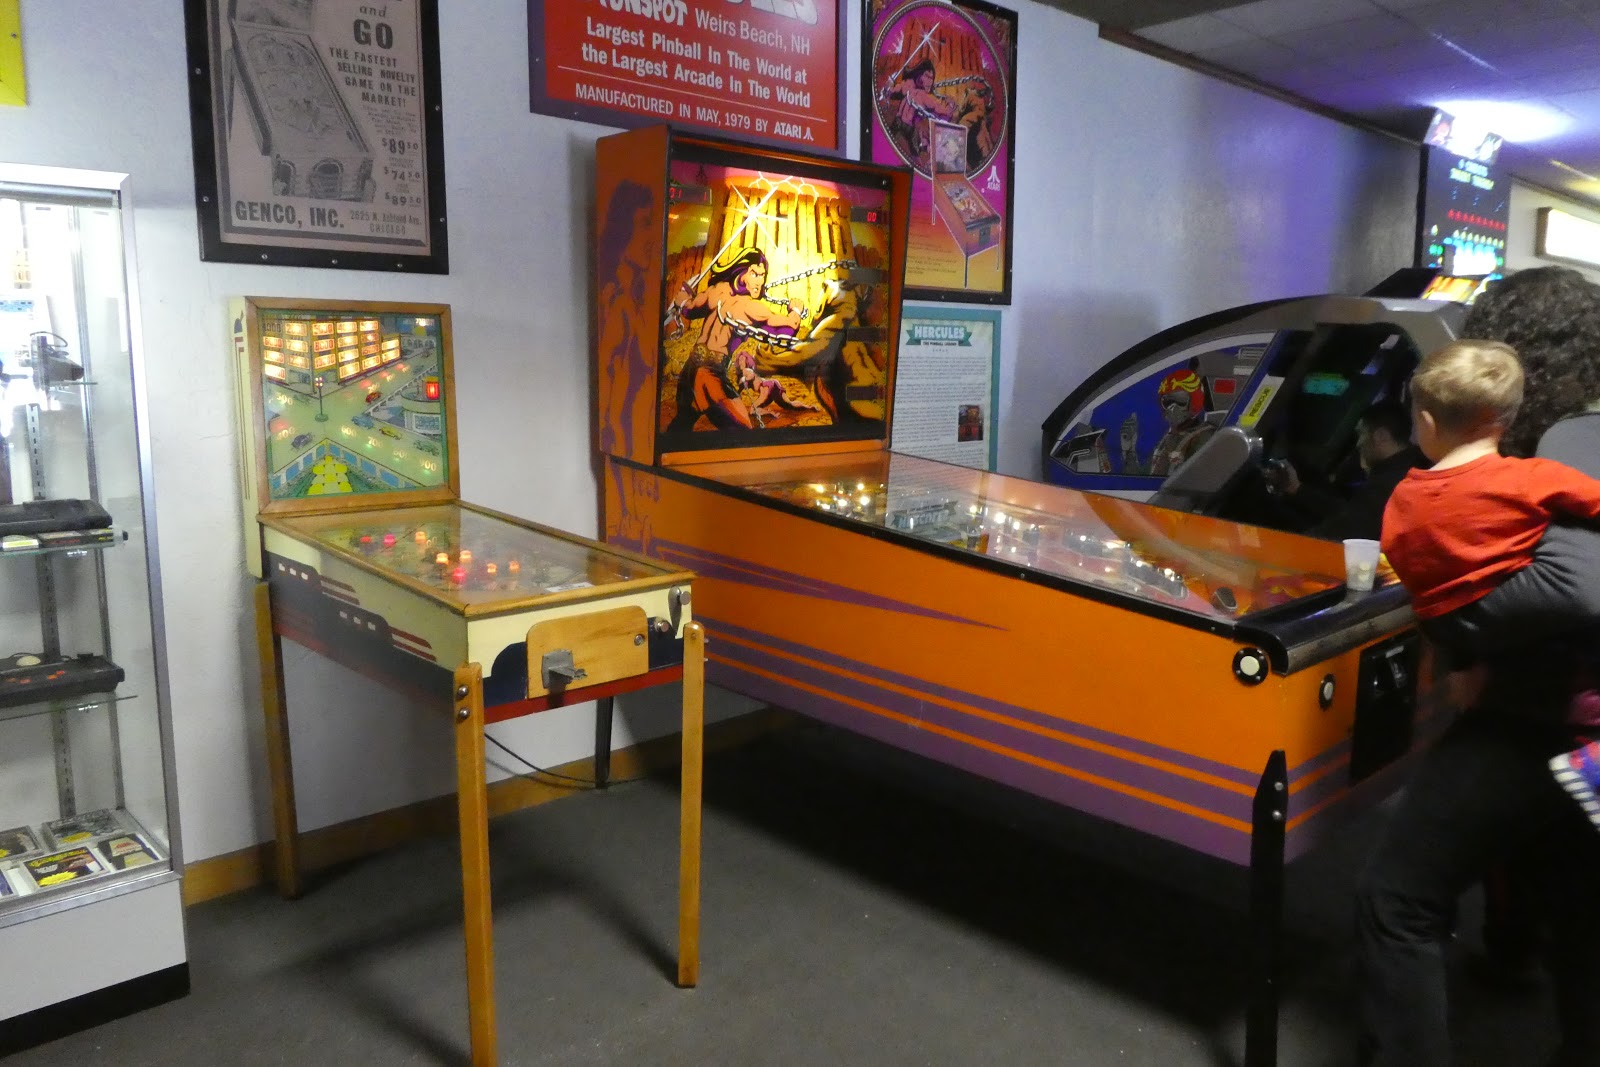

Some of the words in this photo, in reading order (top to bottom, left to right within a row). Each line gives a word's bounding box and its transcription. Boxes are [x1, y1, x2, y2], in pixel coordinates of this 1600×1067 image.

[359, 5, 387, 18] and
[353, 18, 394, 50] GO
[600, 0, 689, 27] UNSPOT
[694, 7, 737, 38] Weirs
[740, 20, 788, 54] Beach,
[791, 33, 811, 56] NH
[329, 47, 349, 60] THE
[354, 51, 397, 68] FASTEST
[586, 15, 645, 48] Largest
[652, 32, 702, 61] Pinball
[708, 45, 722, 65] In
[726, 49, 751, 72] The
[756, 57, 792, 82] World
[794, 68, 808, 86] at
[337, 61, 373, 77] SELLING
[380, 69, 416, 84] NOVELTY
[345, 76, 373, 90] GAME
[380, 82, 392, 93] ON
[398, 84, 416, 97] THE
[581, 42, 608, 65] the
[612, 48, 669, 79] Largest
[674, 63, 723, 90] Arcade
[729, 75, 743, 94] In
[747, 79, 771, 100] The
[775, 85, 811, 109] World
[575, 82, 674, 116] MANUFACTURED
[679, 103, 691, 119] IN
[696, 106, 722, 127] MAY,
[724, 112, 751, 130] 1979
[755, 118, 769, 133] BY
[773, 121, 802, 139] ATARI
[235, 200, 302, 229] GENCO,
[309, 206, 345, 229] INC.
[914, 325, 966, 340] HERCULES
